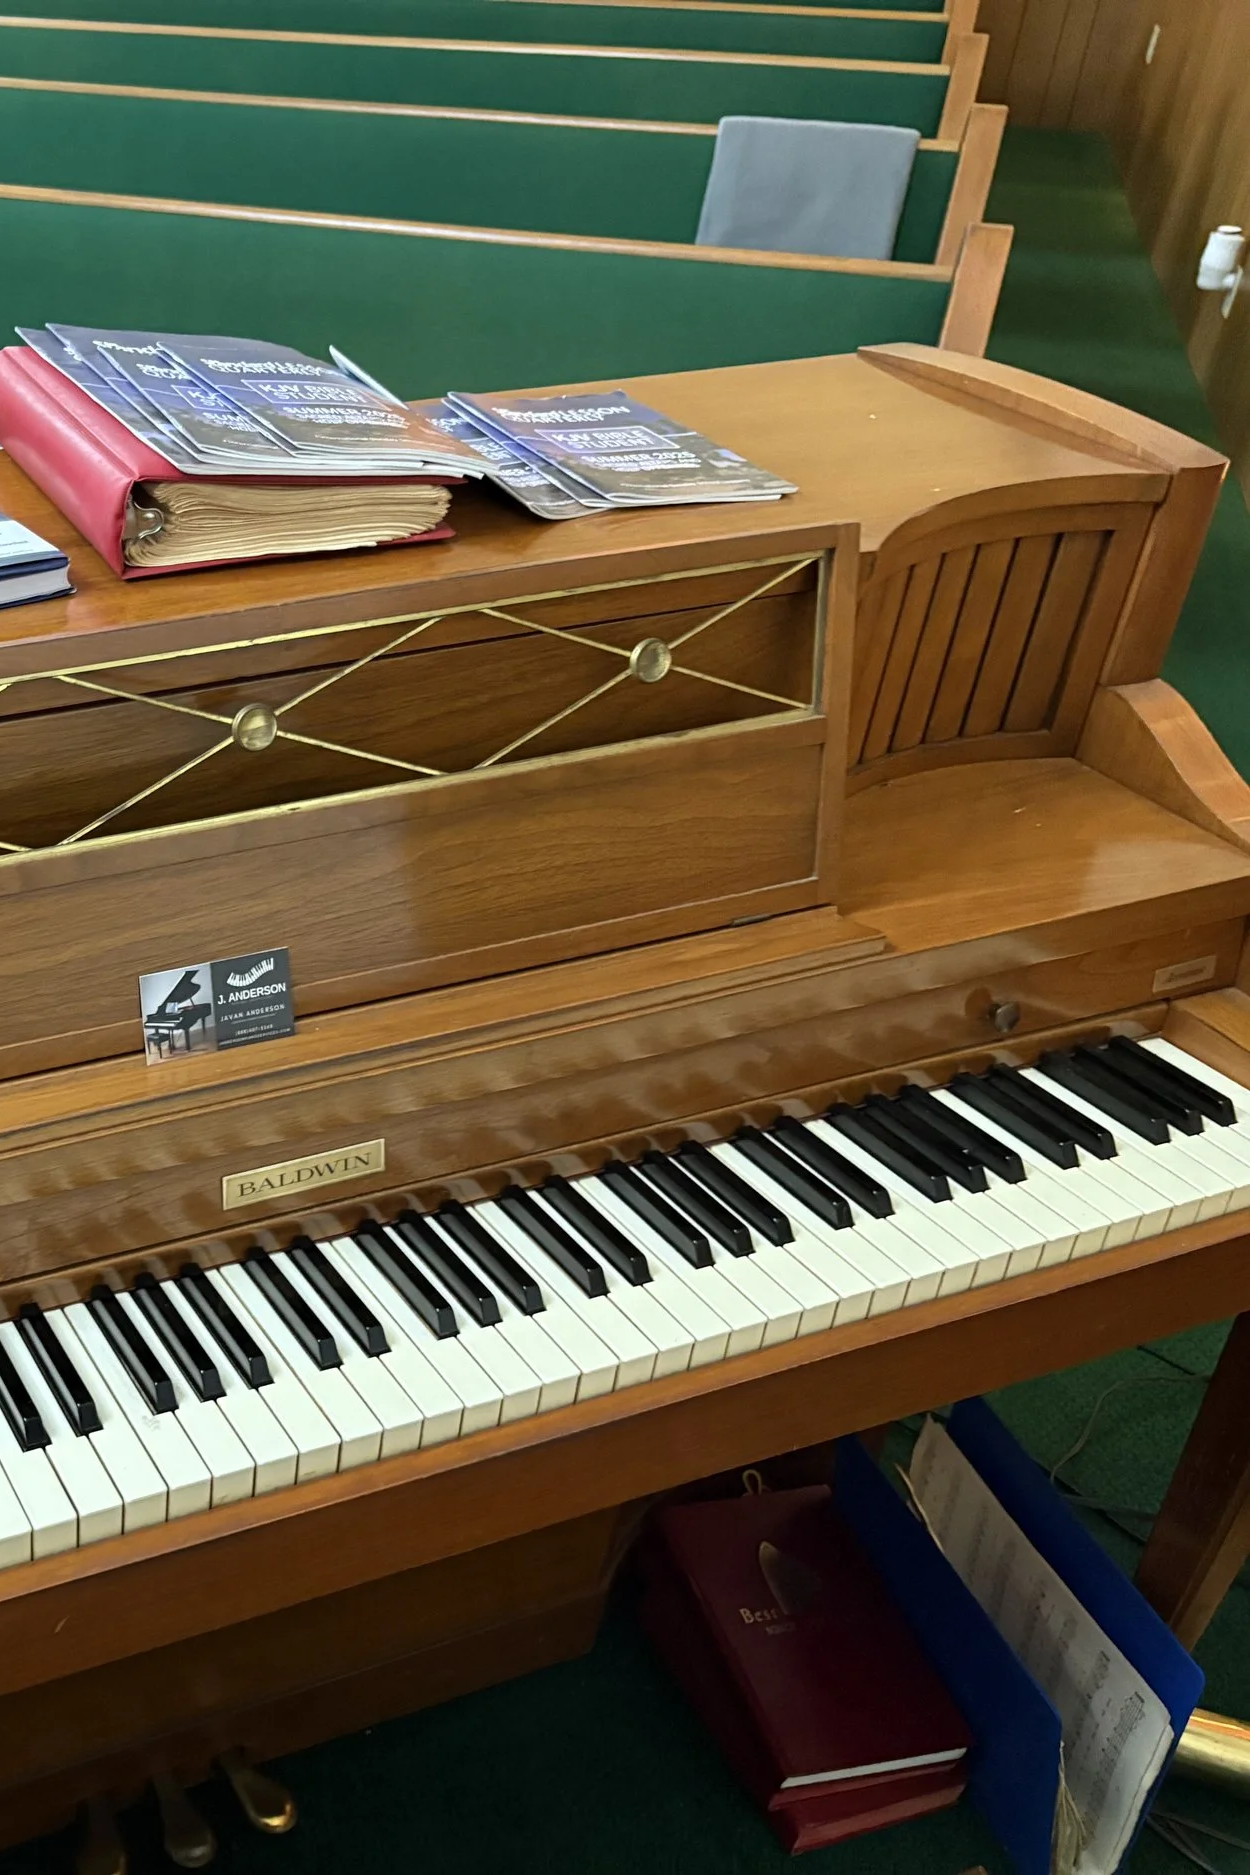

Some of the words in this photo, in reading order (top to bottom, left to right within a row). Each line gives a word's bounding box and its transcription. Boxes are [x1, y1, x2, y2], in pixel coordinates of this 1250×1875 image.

[273, 392, 367, 403] STUDENT
[283, 406, 361, 415] SUMMER
[551, 433, 590, 441] KJV
[592, 430, 643, 440] BIBLE
[568, 438, 655, 449] STUDENT
[581, 453, 653, 463] SUMMER
[652, 451, 696, 459] 2025
[217, 994, 227, 1005] J.
[228, 982, 287, 1004] ANDERSON
[220, 1011, 244, 1023] JAVAN
[246, 1003, 286, 1016] ANDERSON
[237, 1152, 372, 1198] BALDWIN
